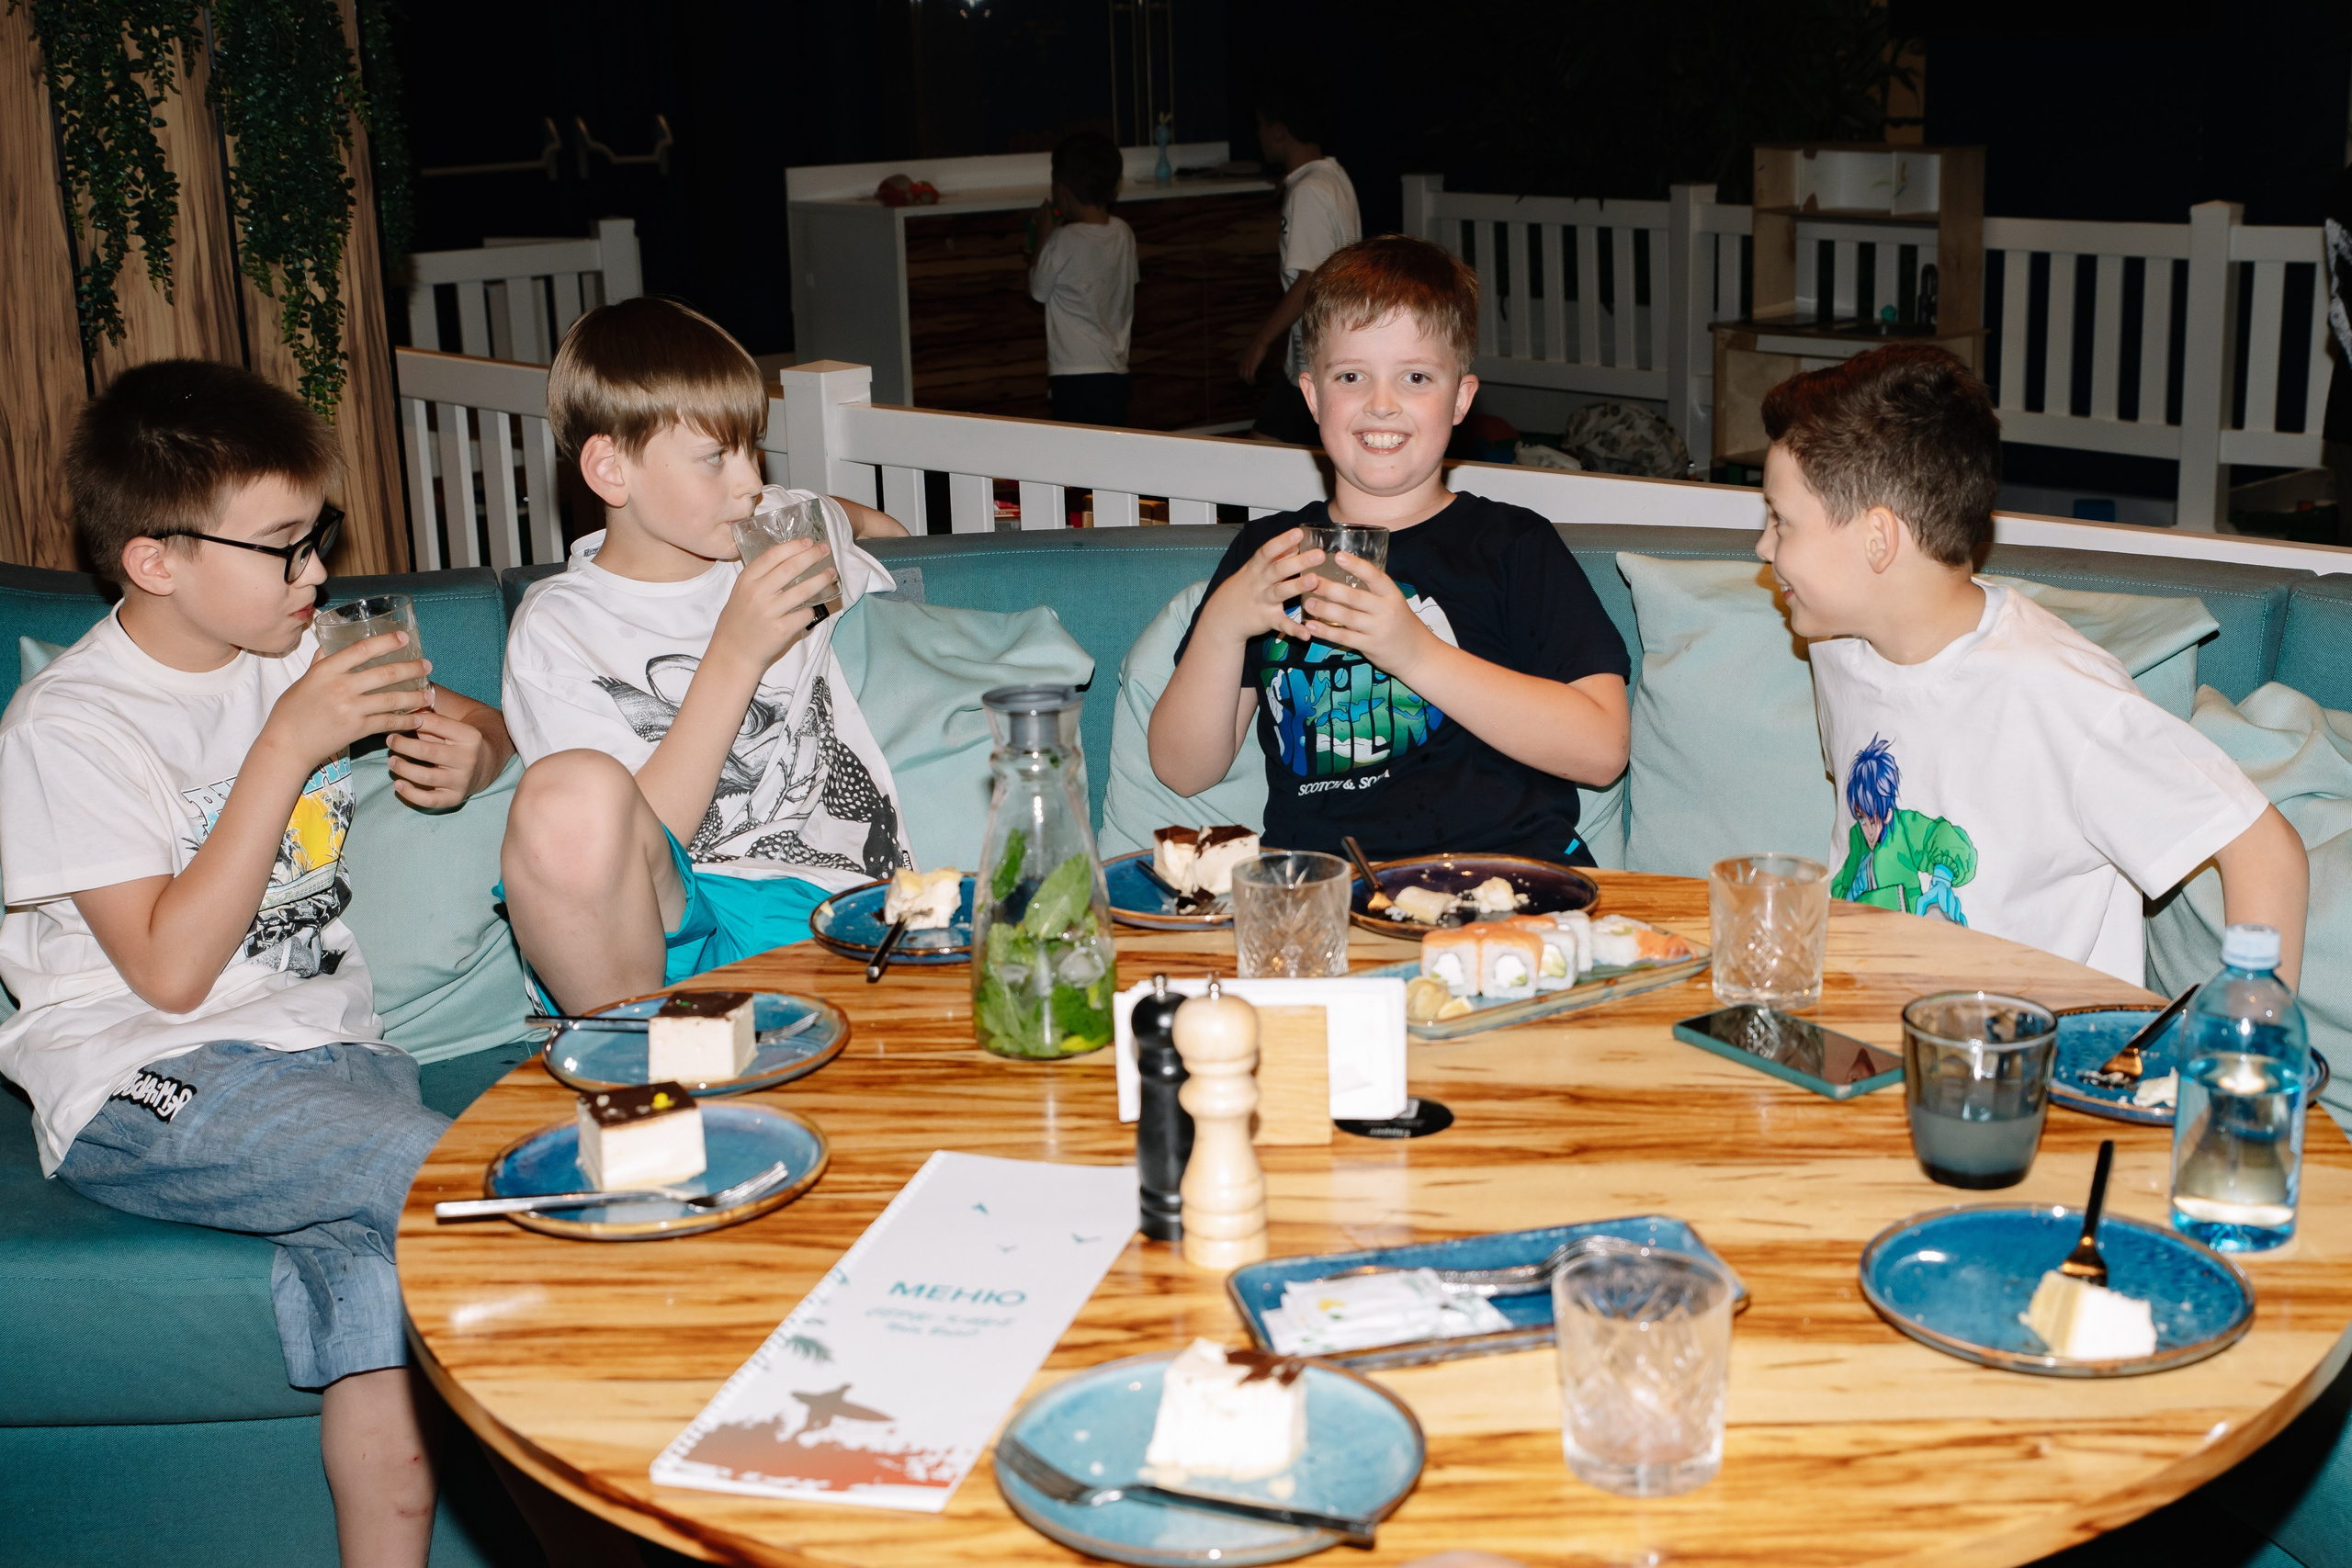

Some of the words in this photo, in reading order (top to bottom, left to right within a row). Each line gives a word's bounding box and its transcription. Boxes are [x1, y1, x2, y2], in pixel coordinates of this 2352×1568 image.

[1298, 780, 1344, 796] SCOTCH
[1342, 778, 1356, 791] &
[1358, 769, 1391, 790] SOA
[888, 1280, 1028, 1307] МЕНЮ
